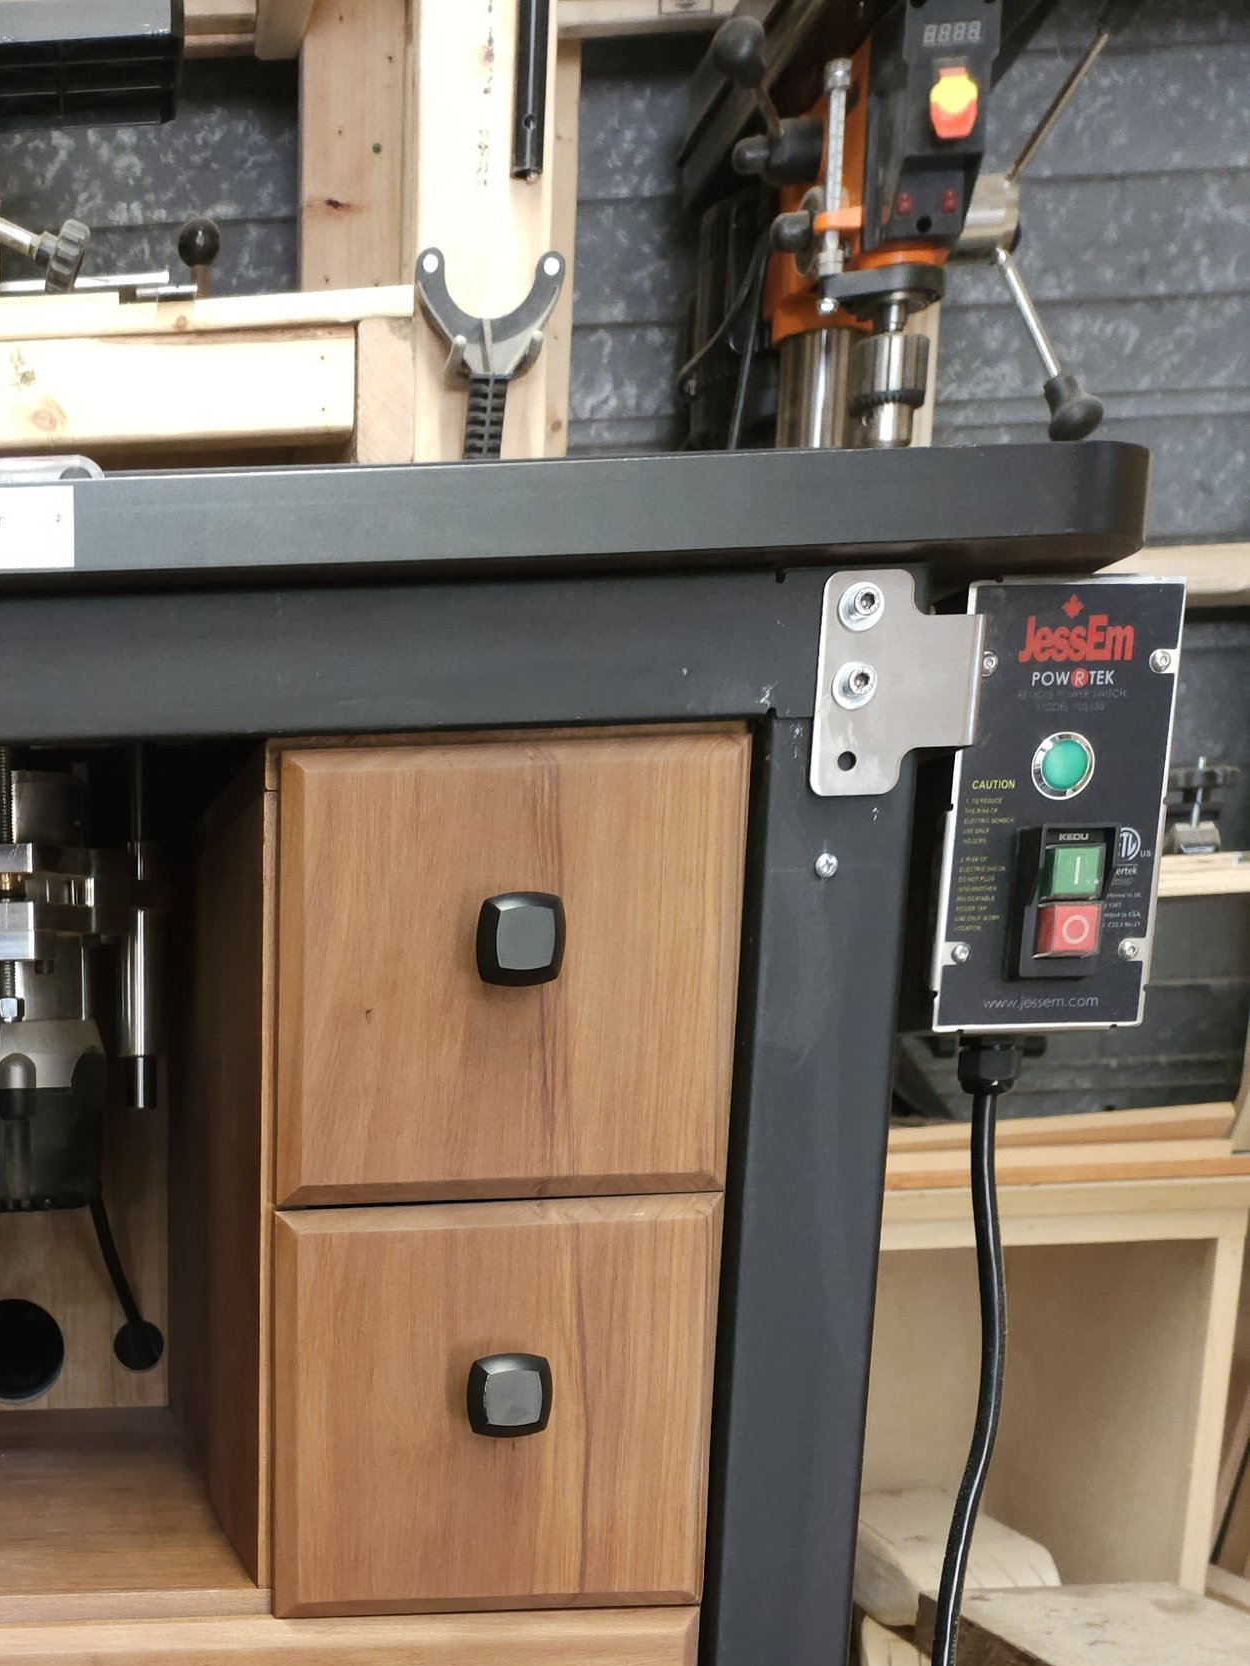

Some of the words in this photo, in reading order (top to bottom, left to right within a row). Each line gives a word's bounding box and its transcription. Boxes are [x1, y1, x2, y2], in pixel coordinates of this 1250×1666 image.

[1018, 614, 1135, 664] JessEm
[971, 779, 1016, 790] CAUTION
[1059, 833, 1090, 841] KEDU
[1139, 850, 1152, 858] US
[983, 996, 1099, 1012] www.jessem.com
